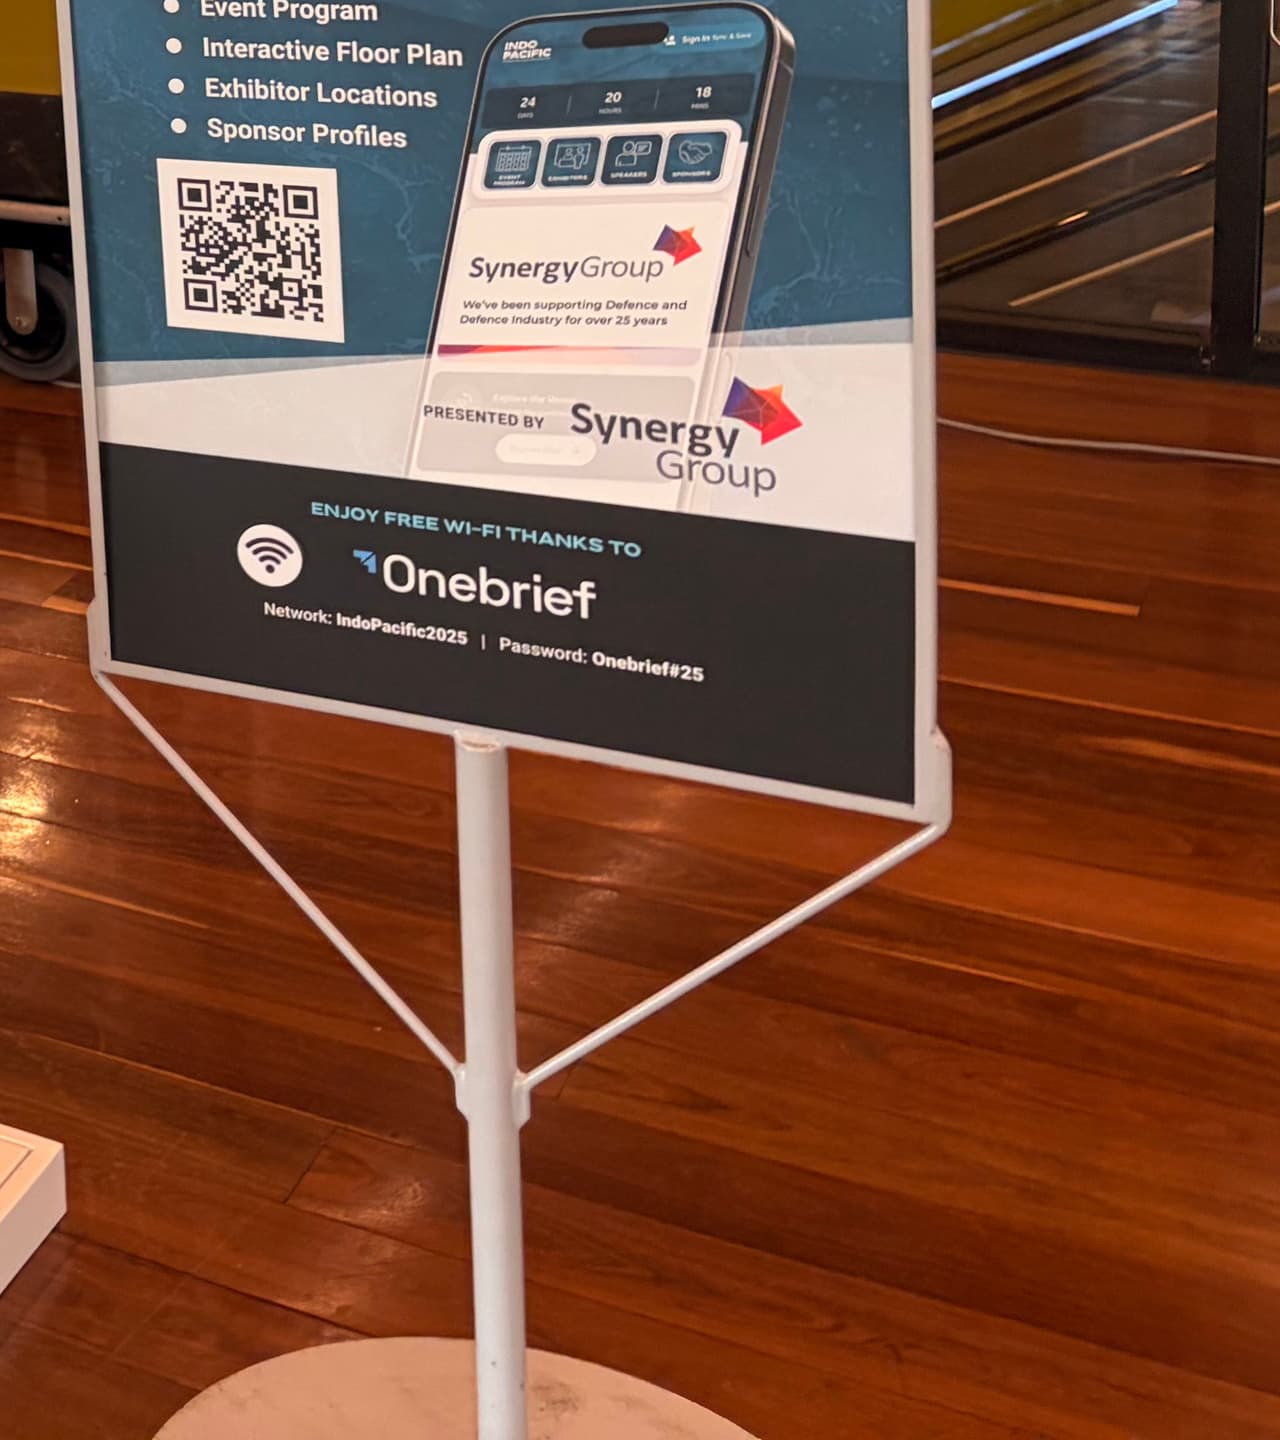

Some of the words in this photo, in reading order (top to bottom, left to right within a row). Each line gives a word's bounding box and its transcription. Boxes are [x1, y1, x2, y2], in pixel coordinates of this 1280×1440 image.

[504, 39, 538, 51] INDO
[682, 34, 701, 44] Sign
[202, 37, 329, 61] Interactive
[336, 41, 400, 64] Floor
[406, 44, 463, 66] Plan
[502, 48, 552, 61] PACIFIC
[205, 78, 310, 102] Exhibitor
[317, 82, 438, 108] Locations
[604, 91, 622, 103] 20
[695, 86, 712, 98] 18
[520, 96, 536, 108] 24
[207, 118, 305, 143] Sponsor
[312, 123, 407, 148] Profiles
[610, 171, 647, 179] SPEAKERS
[463, 299, 498, 310] We've
[501, 300, 531, 310] been
[534, 300, 602, 312] supporting
[605, 299, 659, 310] Defence
[662, 300, 688, 310] and
[460, 314, 508, 325] Defence
[511, 314, 562, 327] Industry
[565, 314, 583, 325] for
[585, 316, 612, 325] over
[615, 315, 631, 325] 25
[633, 316, 668, 327] years
[423, 404, 519, 428] PRESENTED
[523, 415, 545, 430] BY
[570, 402, 740, 459] Synergy
[655, 449, 777, 498] Group
[311, 501, 380, 523] ENJOY
[384, 510, 439, 532] FREE
[443, 518, 501, 539] WI-FI
[505, 526, 604, 554] THANKS
[608, 539, 642, 558] TO
[382, 553, 597, 620] Onebrief
[263, 601, 332, 626] Network:
[336, 613, 468, 646] IndoPacific2025
[499, 637, 588, 664] Password:
[591, 650, 705, 682] Onebrief#25
